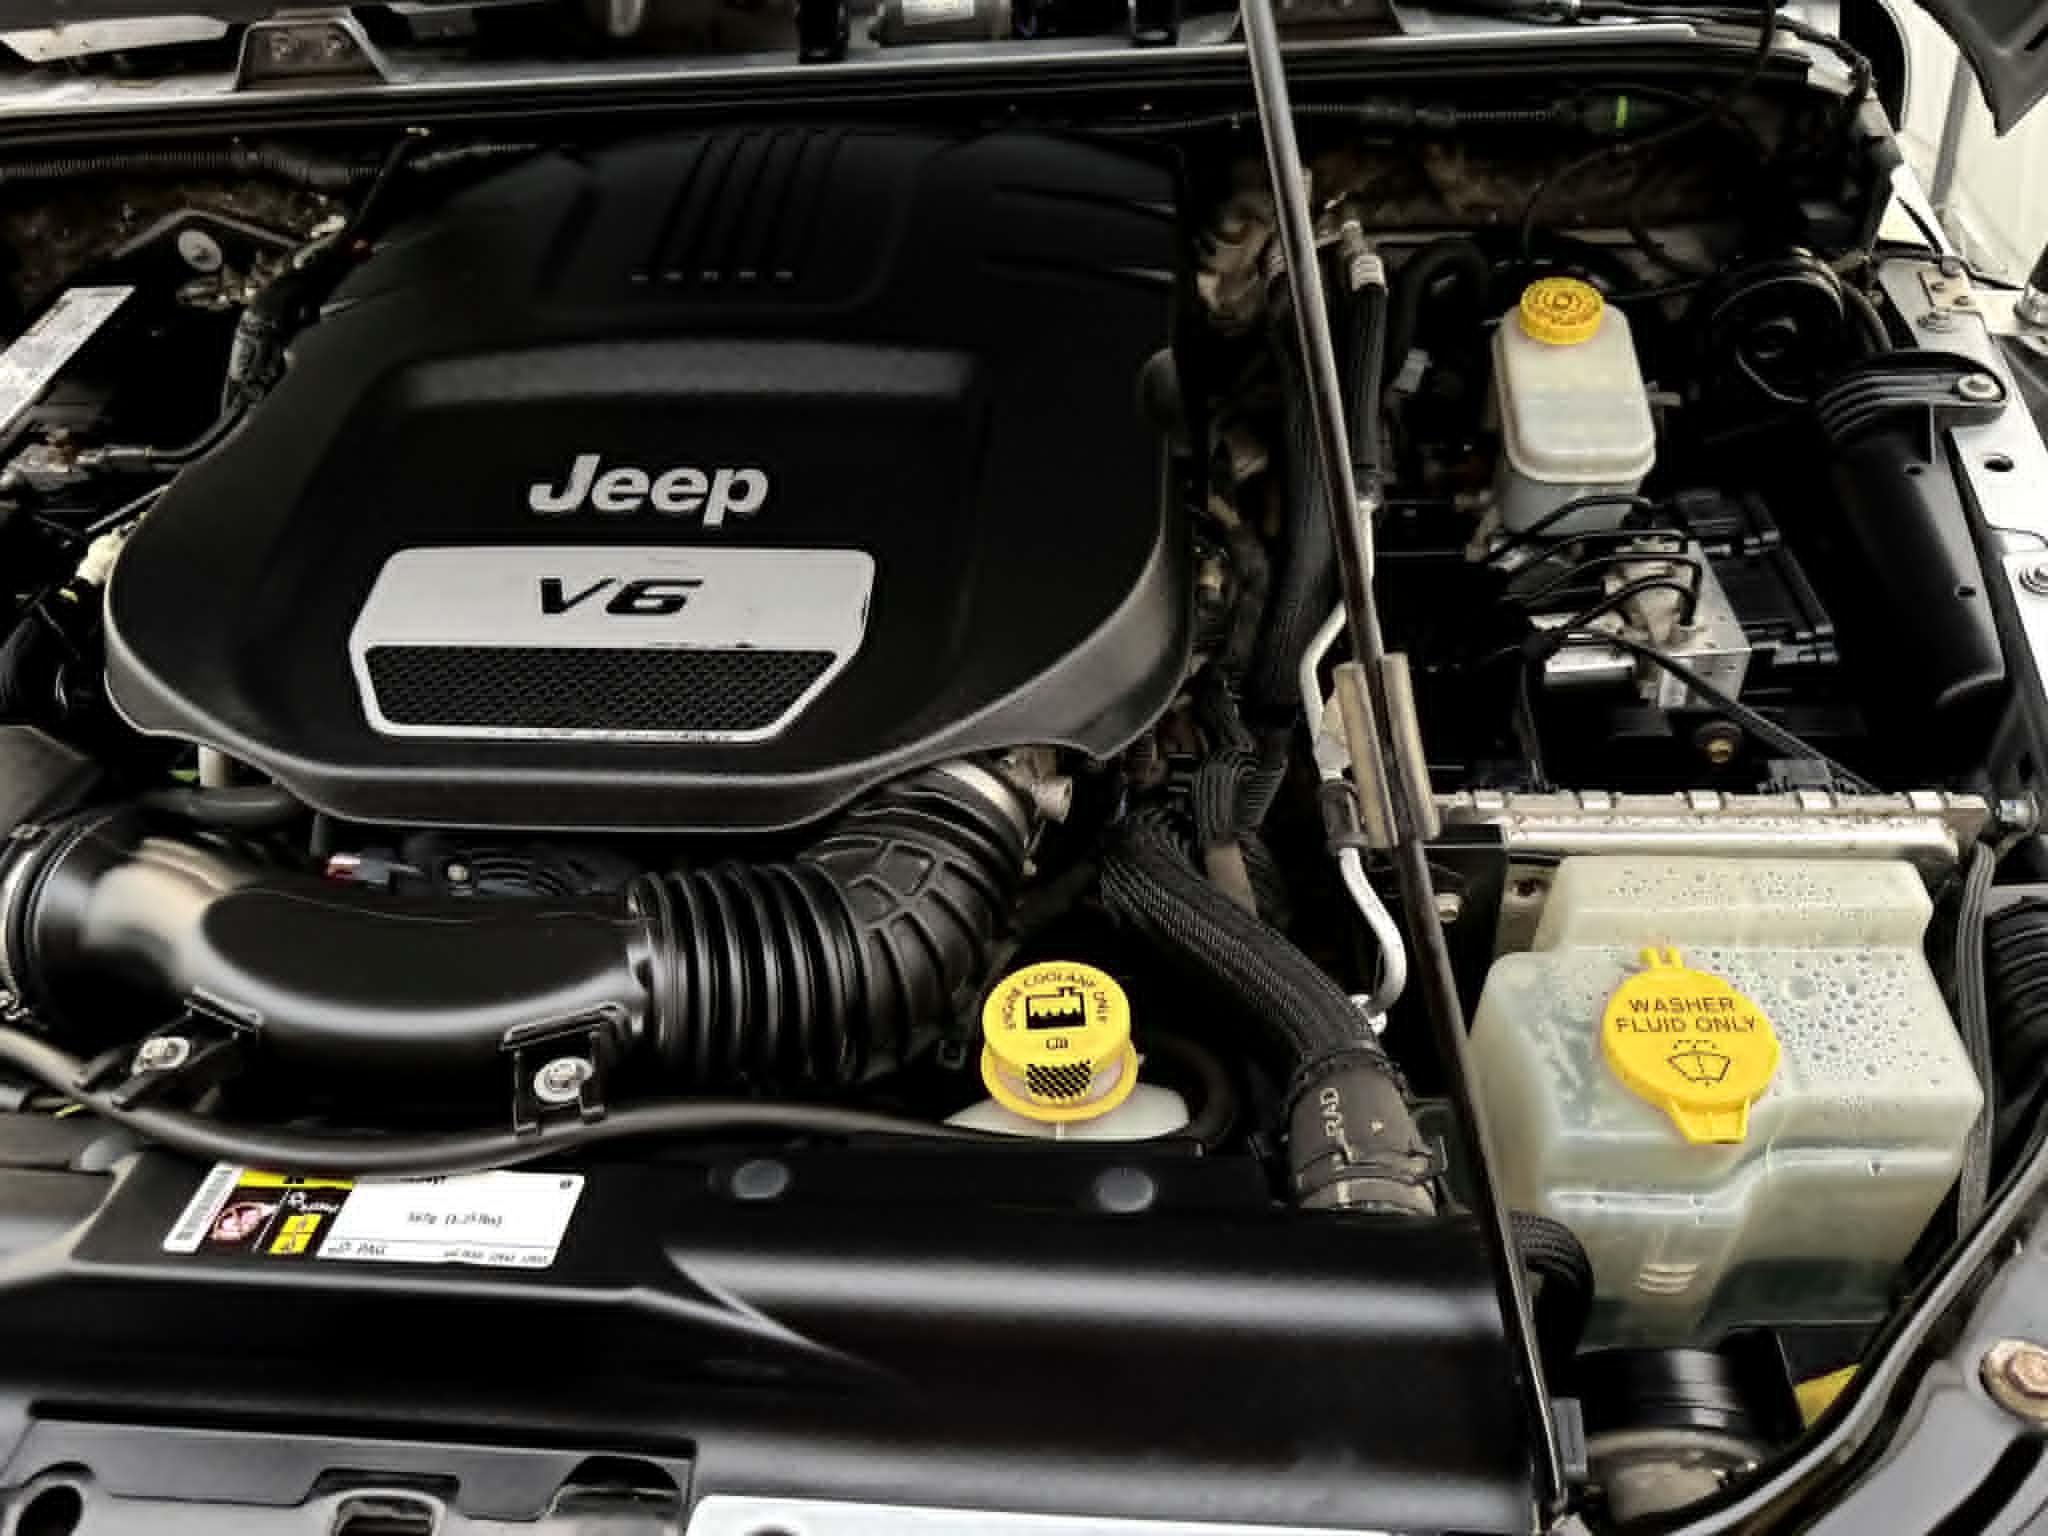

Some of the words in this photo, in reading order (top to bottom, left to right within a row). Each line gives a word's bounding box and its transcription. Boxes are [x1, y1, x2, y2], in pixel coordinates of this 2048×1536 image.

[529, 453, 769, 528] Jeep
[540, 578, 704, 615] V6
[1629, 997, 1736, 1013] WASHER
[1615, 1016, 1686, 1033] FLUID
[1695, 1015, 1756, 1033] ONLY
